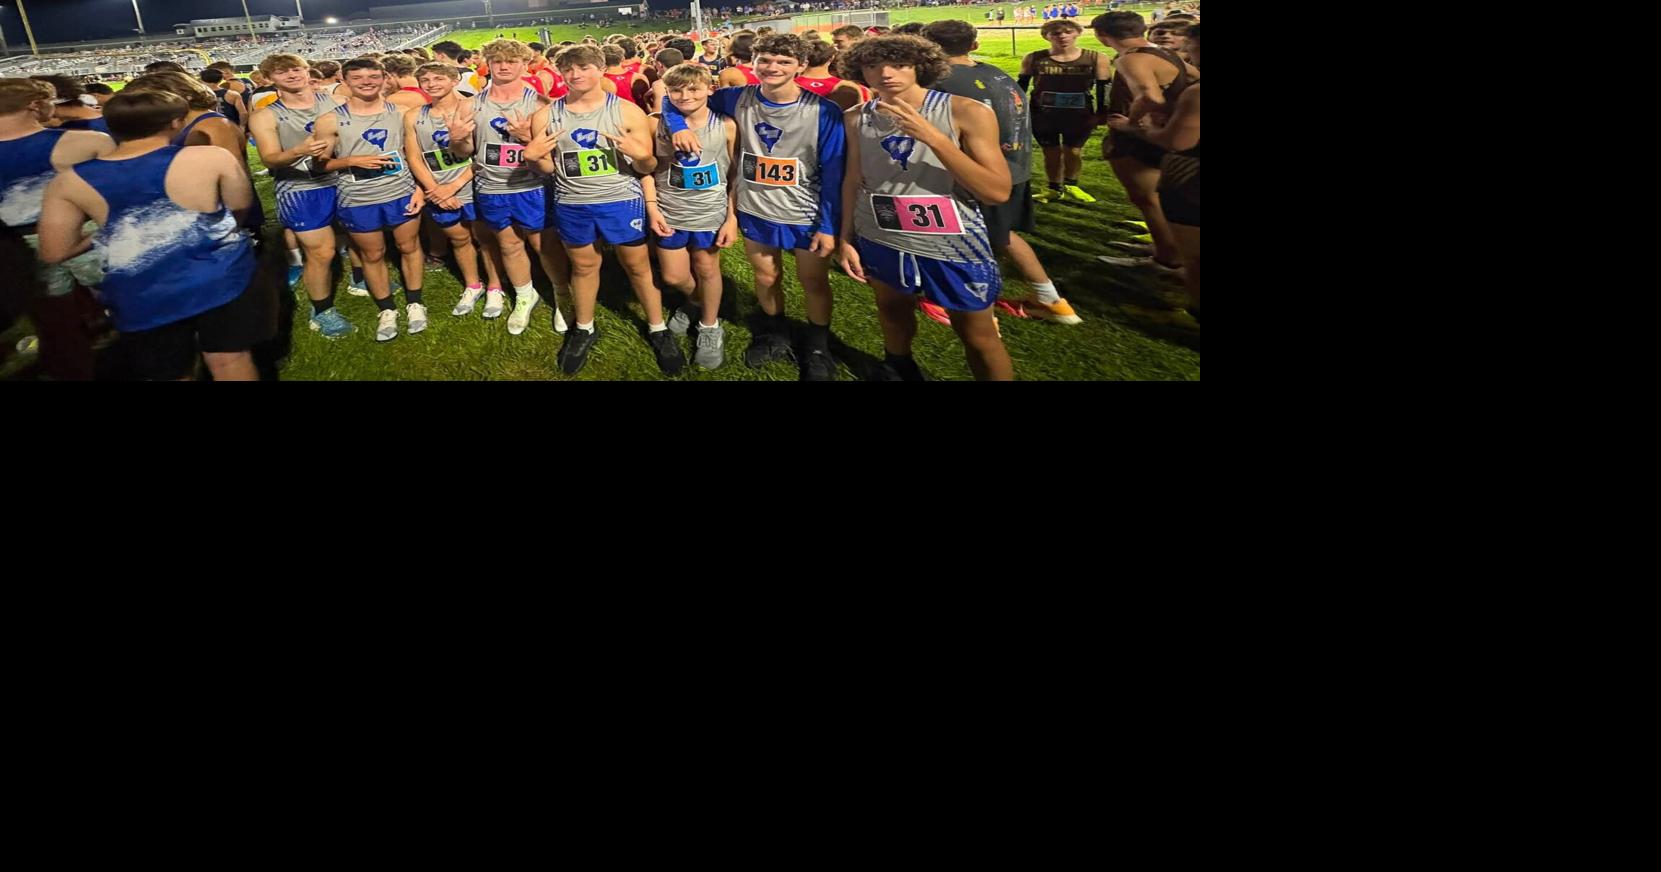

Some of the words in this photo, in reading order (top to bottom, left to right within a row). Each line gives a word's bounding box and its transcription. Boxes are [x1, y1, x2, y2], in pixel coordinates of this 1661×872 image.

[587, 155, 608, 172] 31
[759, 163, 794, 181] 143
[691, 171, 711, 186] 31
[908, 204, 945, 228] 31
